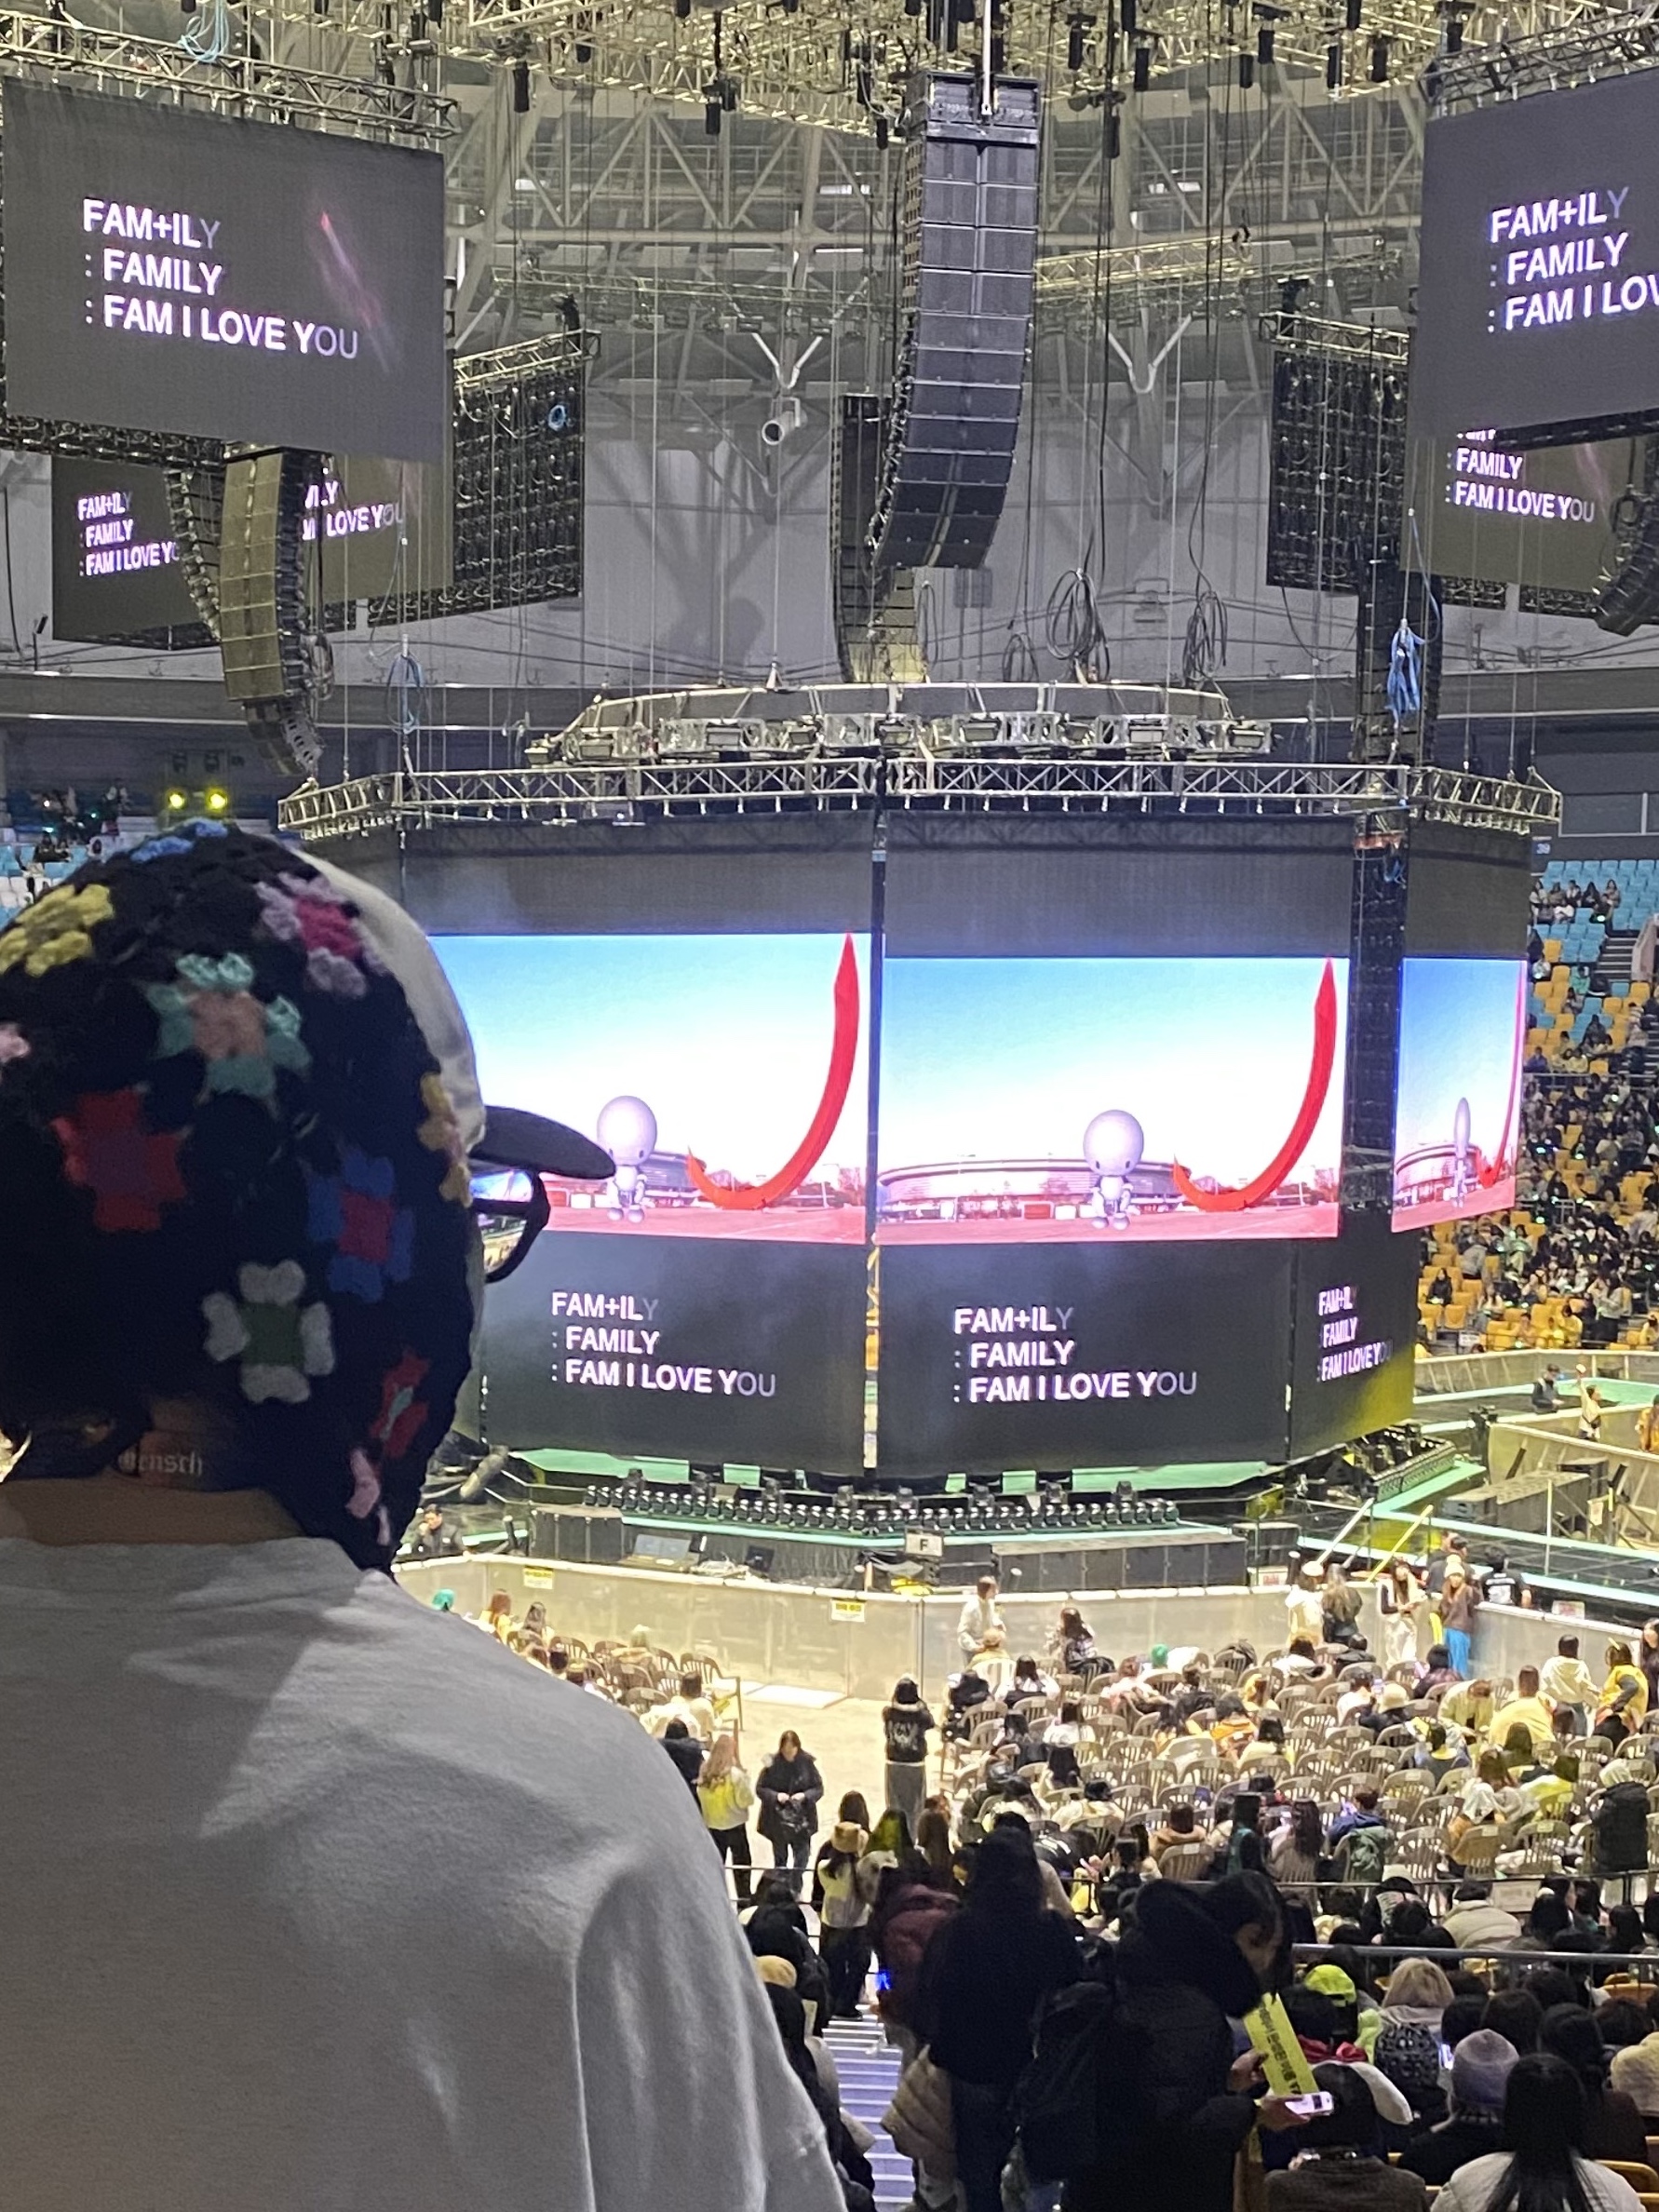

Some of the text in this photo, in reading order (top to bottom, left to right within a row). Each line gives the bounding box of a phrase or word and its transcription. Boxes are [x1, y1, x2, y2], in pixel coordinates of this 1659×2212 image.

[82, 197, 222, 250] FAM+ILY
[1490, 186, 1629, 243] FAM+ILY
[102, 247, 223, 296] FAMILY
[1506, 232, 1629, 285] FAMILY
[1504, 288, 1574, 330] FAM
[1583, 284, 1593, 318] I
[102, 293, 173, 335] FAM
[182, 304, 192, 339] I
[199, 307, 288, 353] LOVE
[292, 320, 359, 360] YOU
[1455, 447, 1523, 479] FAMILY
[77, 492, 132, 521] FAM+ILY
[1454, 480, 1494, 510] FAM
[1498, 487, 1504, 512] I
[1506, 488, 1556, 519] LOVE
[1558, 495, 1595, 523] YOU
[86, 519, 134, 548] FAMILY
[326, 506, 371, 537] LOVE
[86, 550, 115, 576] FAM
[123, 543, 161, 571] LOVE
[551, 1291, 659, 1322] FAM+ILY
[954, 1305, 1074, 1334] FAM+ILY
[565, 1325, 661, 1356] FAMILY
[1323, 1315, 1358, 1349] FAMILY
[969, 1340, 1075, 1369] FAMILY
[1347, 1343, 1373, 1374] LOVE
[564, 1358, 620, 1387] FAM
[626, 1362, 635, 1388] I
[641, 1363, 713, 1394] LOVE
[718, 1368, 776, 1396] YOU
[968, 1375, 1030, 1403] FAM
[1038, 1374, 1045, 1401] I
[1053, 1371, 1131, 1400] LOVE
[1136, 1370, 1197, 1396] YOU
[919, 1538, 928, 1551] F
